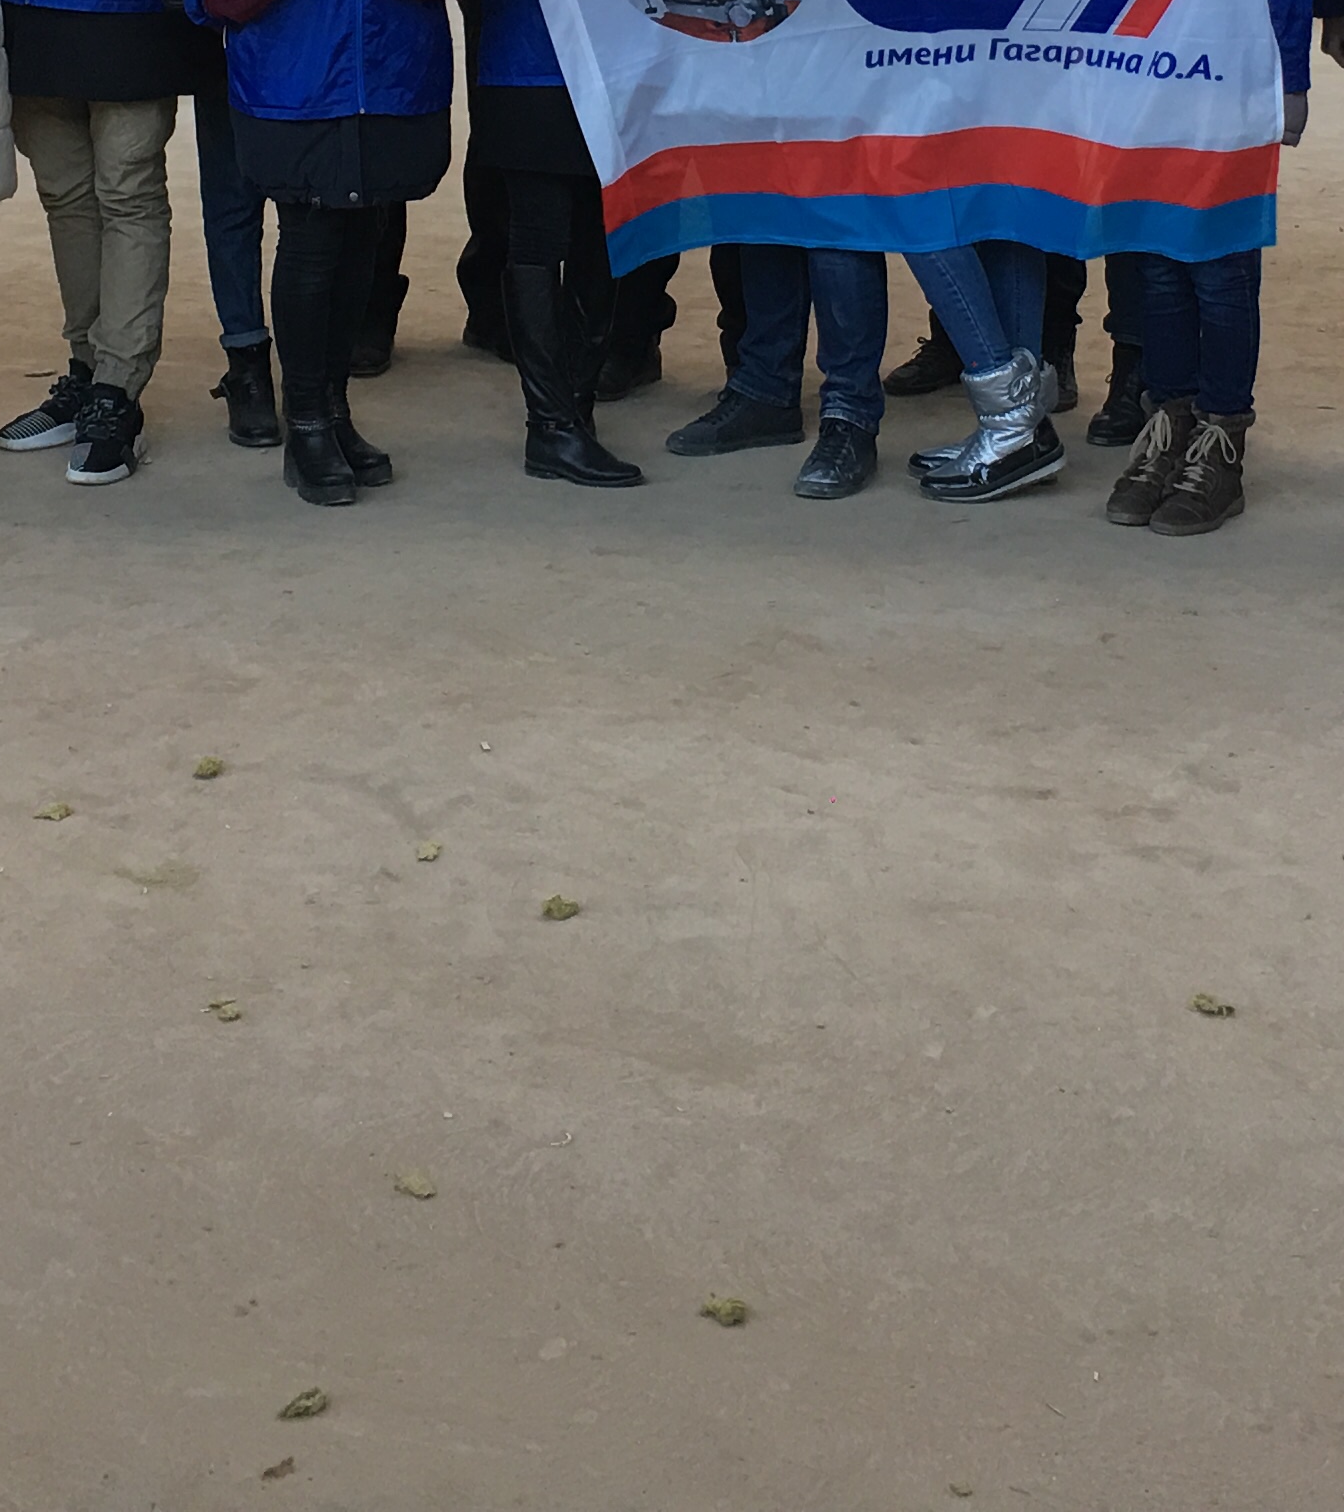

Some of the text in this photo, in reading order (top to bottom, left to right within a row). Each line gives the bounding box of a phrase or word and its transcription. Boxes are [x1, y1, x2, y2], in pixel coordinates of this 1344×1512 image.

[865, 37, 1225, 81] имени Гагарина Ю.А.
